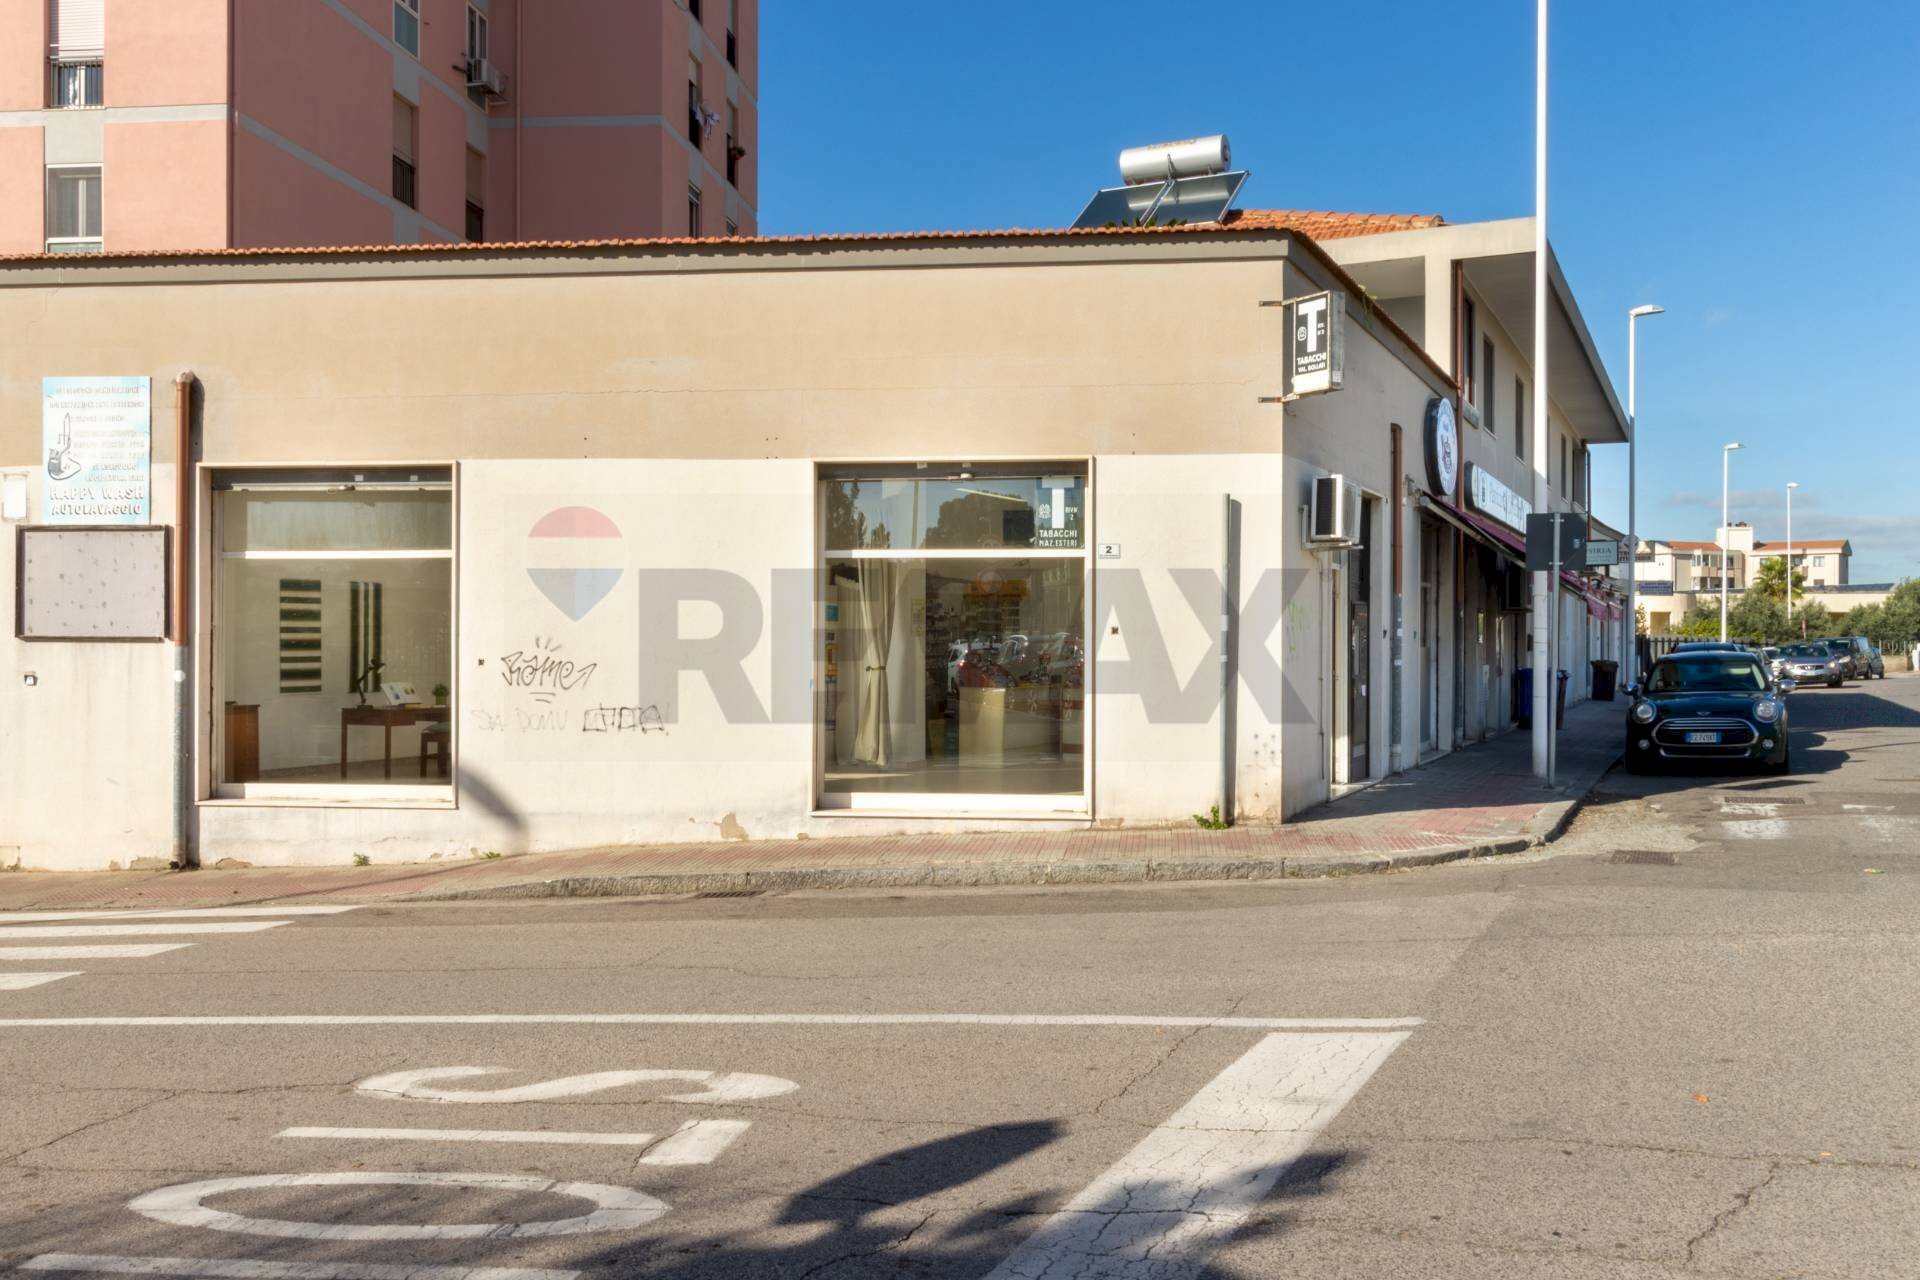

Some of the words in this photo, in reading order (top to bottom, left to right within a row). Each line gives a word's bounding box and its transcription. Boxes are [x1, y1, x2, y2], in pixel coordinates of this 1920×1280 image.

[1298, 297, 1327, 353] T
[1297, 352, 1327, 365] TABACCHI
[49, 486, 95, 500] HAPPY
[101, 486, 144, 500] WASH
[51, 502, 142, 516] AUTOLAVAGGIO
[1041, 477, 1075, 528] T
[1039, 529, 1078, 538] TABACCHI
[1105, 545, 1112, 554] 2
